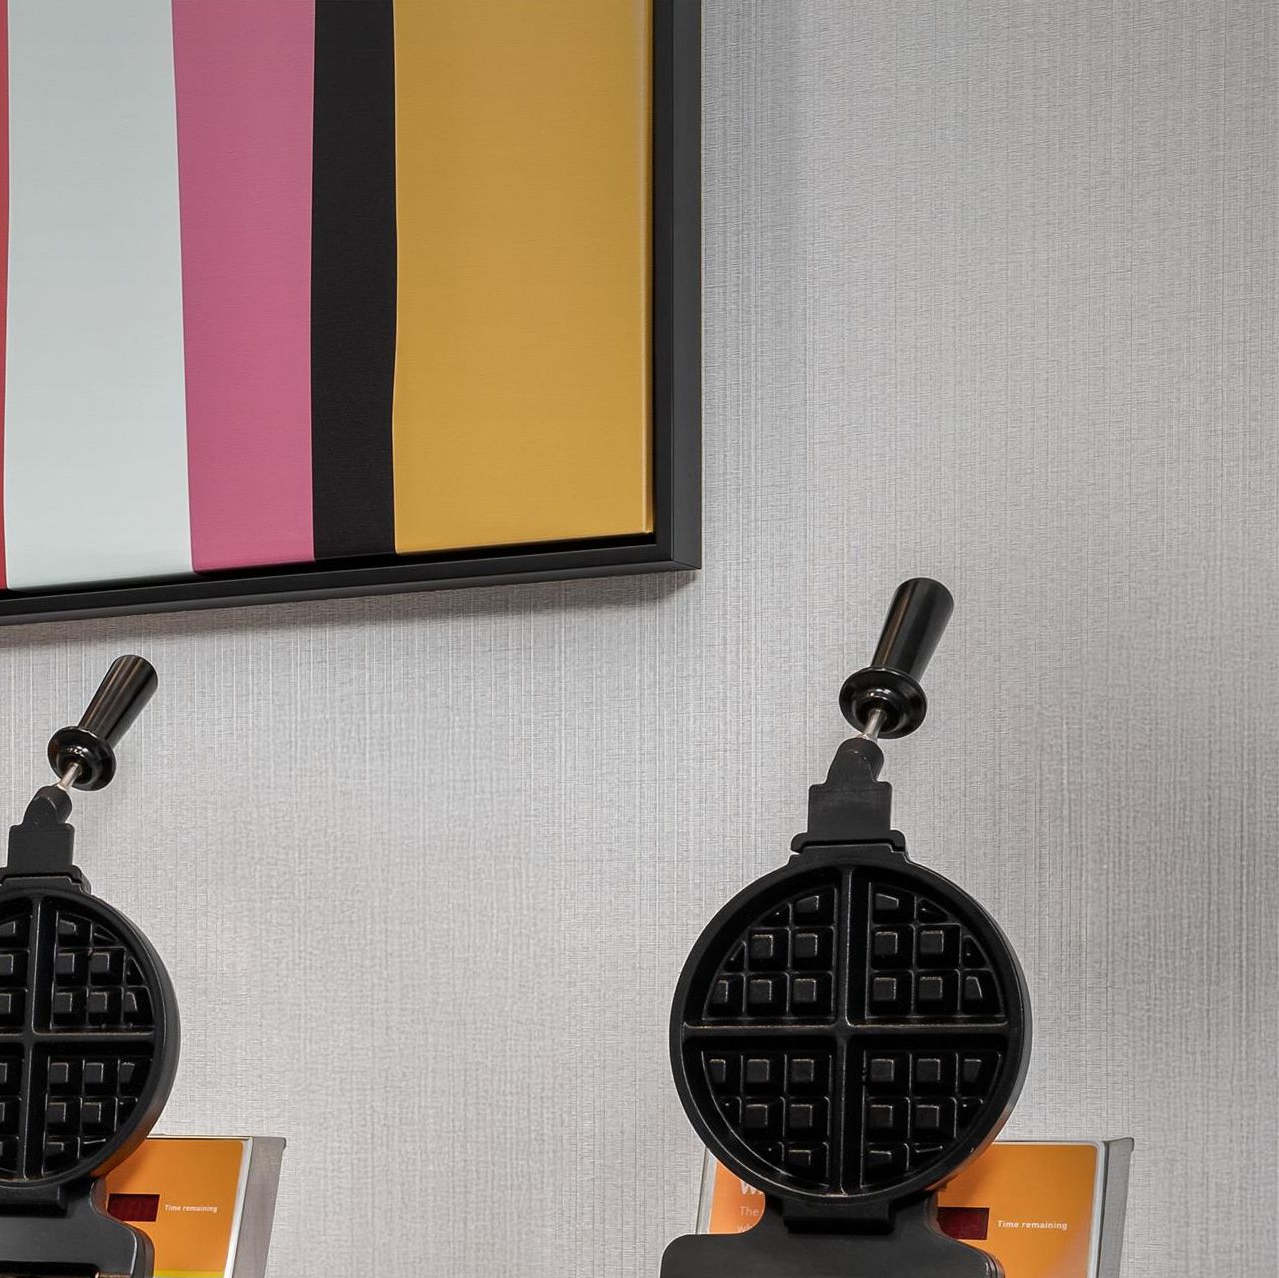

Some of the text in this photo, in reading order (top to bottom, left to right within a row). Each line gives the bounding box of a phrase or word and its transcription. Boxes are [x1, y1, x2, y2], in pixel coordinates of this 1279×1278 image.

[164, 1204, 218, 1214] Time remaining
[739, 1205, 760, 1217] The
[997, 1220, 1068, 1231] Time remaining
